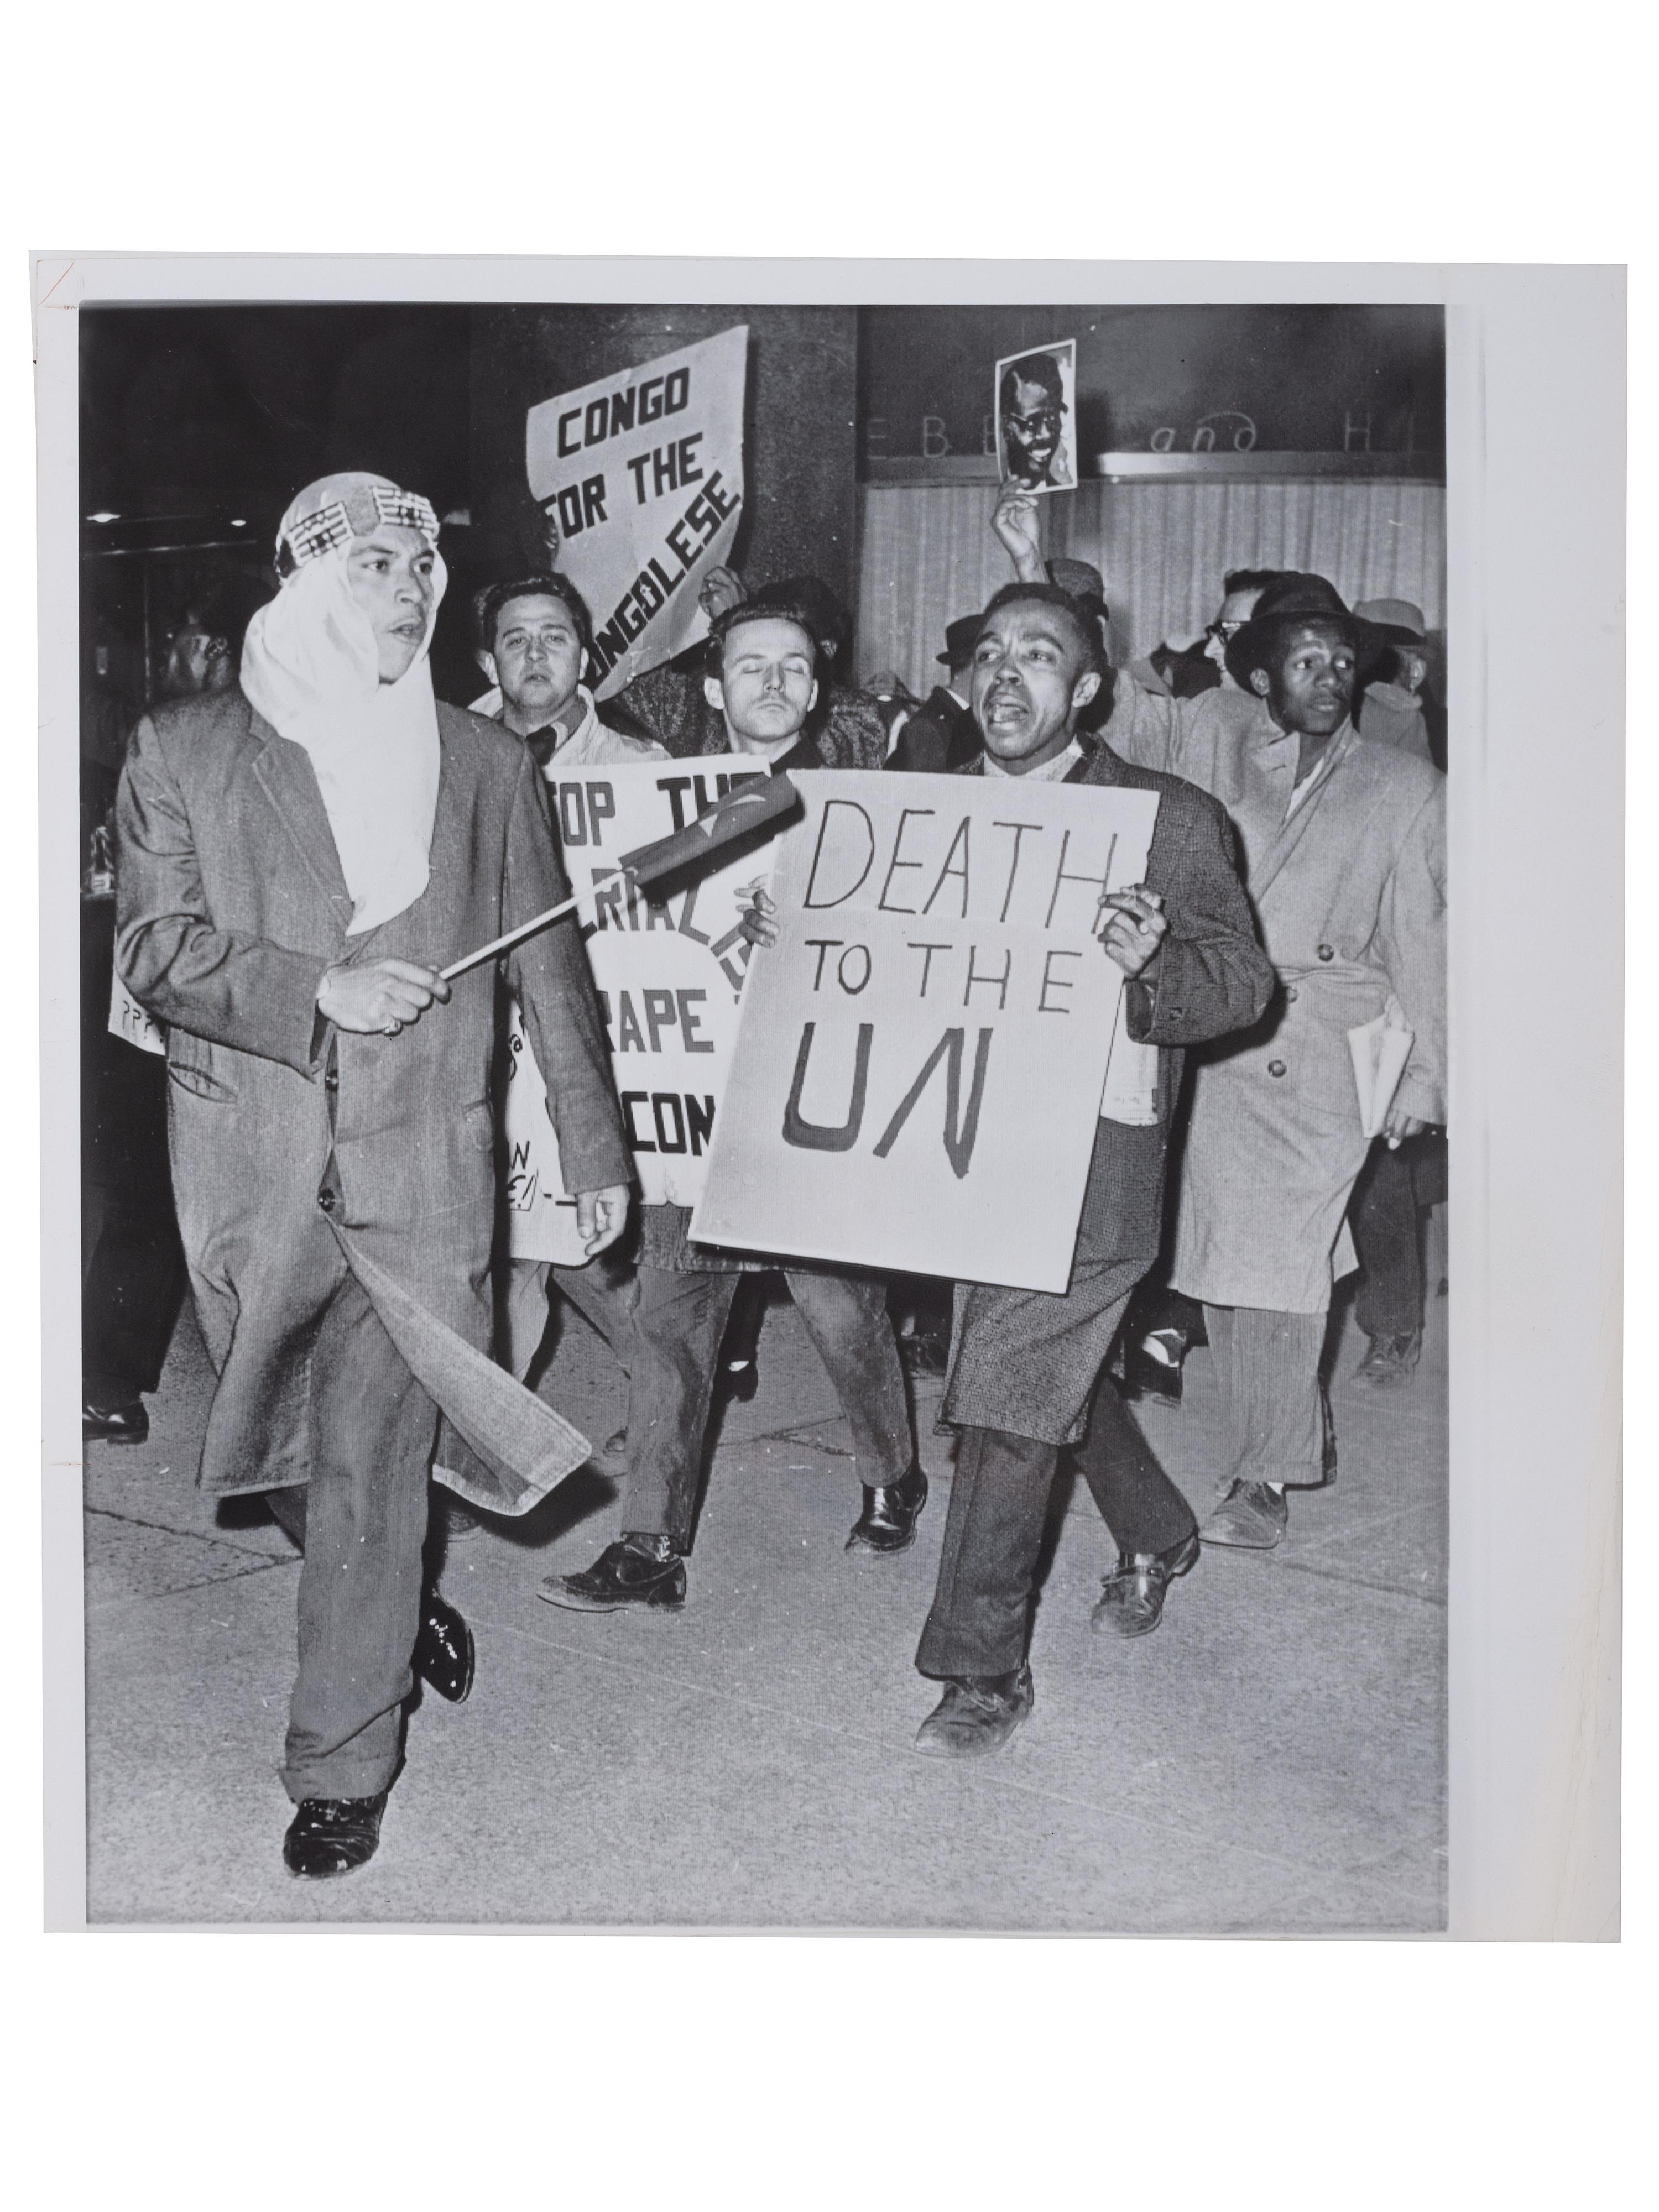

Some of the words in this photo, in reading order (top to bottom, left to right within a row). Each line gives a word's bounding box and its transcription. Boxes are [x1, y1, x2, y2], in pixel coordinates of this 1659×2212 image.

[558, 367, 690, 458] CONGO
[1151, 411, 1256, 453] and
[628, 432, 703, 504] THE
[585, 471, 741, 691] ONGOLESE
[553, 781, 615, 846] OP
[803, 800, 1118, 934] DEATH
[805, 940, 872, 995] TO
[907, 943, 1082, 1013] THE
[782, 1022, 994, 1179] UN
